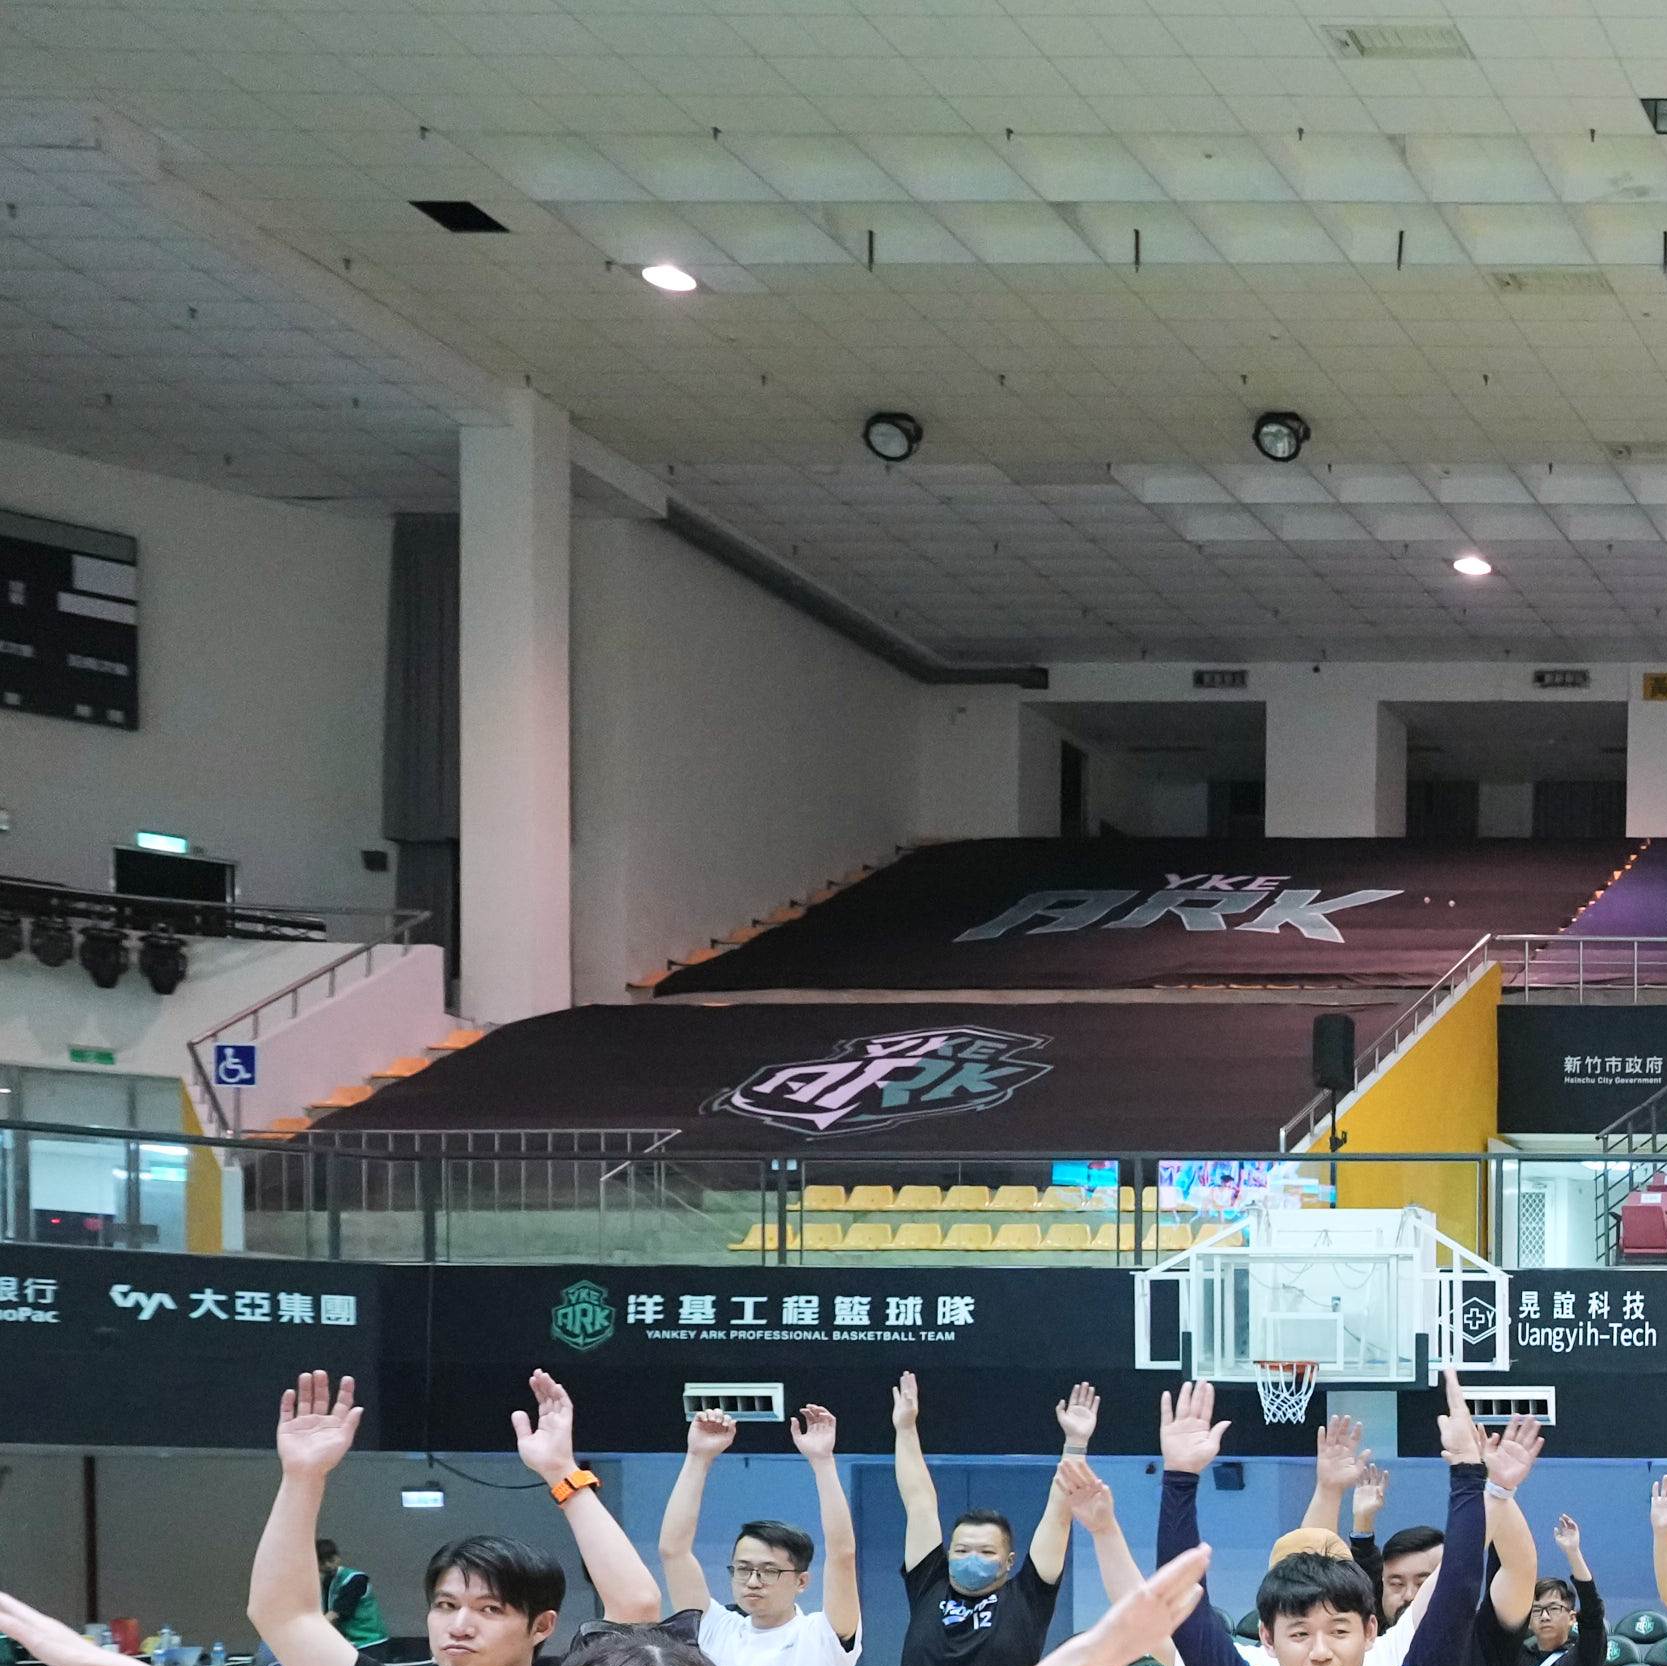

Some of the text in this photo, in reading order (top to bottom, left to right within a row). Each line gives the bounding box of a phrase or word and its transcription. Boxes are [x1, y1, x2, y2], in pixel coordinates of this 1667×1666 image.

[1165, 873, 1291, 892] YKE
[952, 888, 1405, 944] ARK
[860, 1033, 1010, 1060] YKE
[1563, 1055, 1664, 1074] 新竹市政府
[1597, 1075, 1614, 1085] City
[1614, 1075, 1662, 1085] Government
[751, 1056, 1029, 1110] ARK
[188, 1288, 357, 1326] 大亞集團
[557, 1301, 611, 1335] ARK
[627, 1294, 975, 1326] 洋基工程籃球隊
[1518, 1290, 1645, 1320] 晃誼科技
[646, 1329, 956, 1342] YANKEY ARK PROFESSIONAL BASKETBALL TEAM
[1517, 1320, 1657, 1353] Uangyih-Tech
